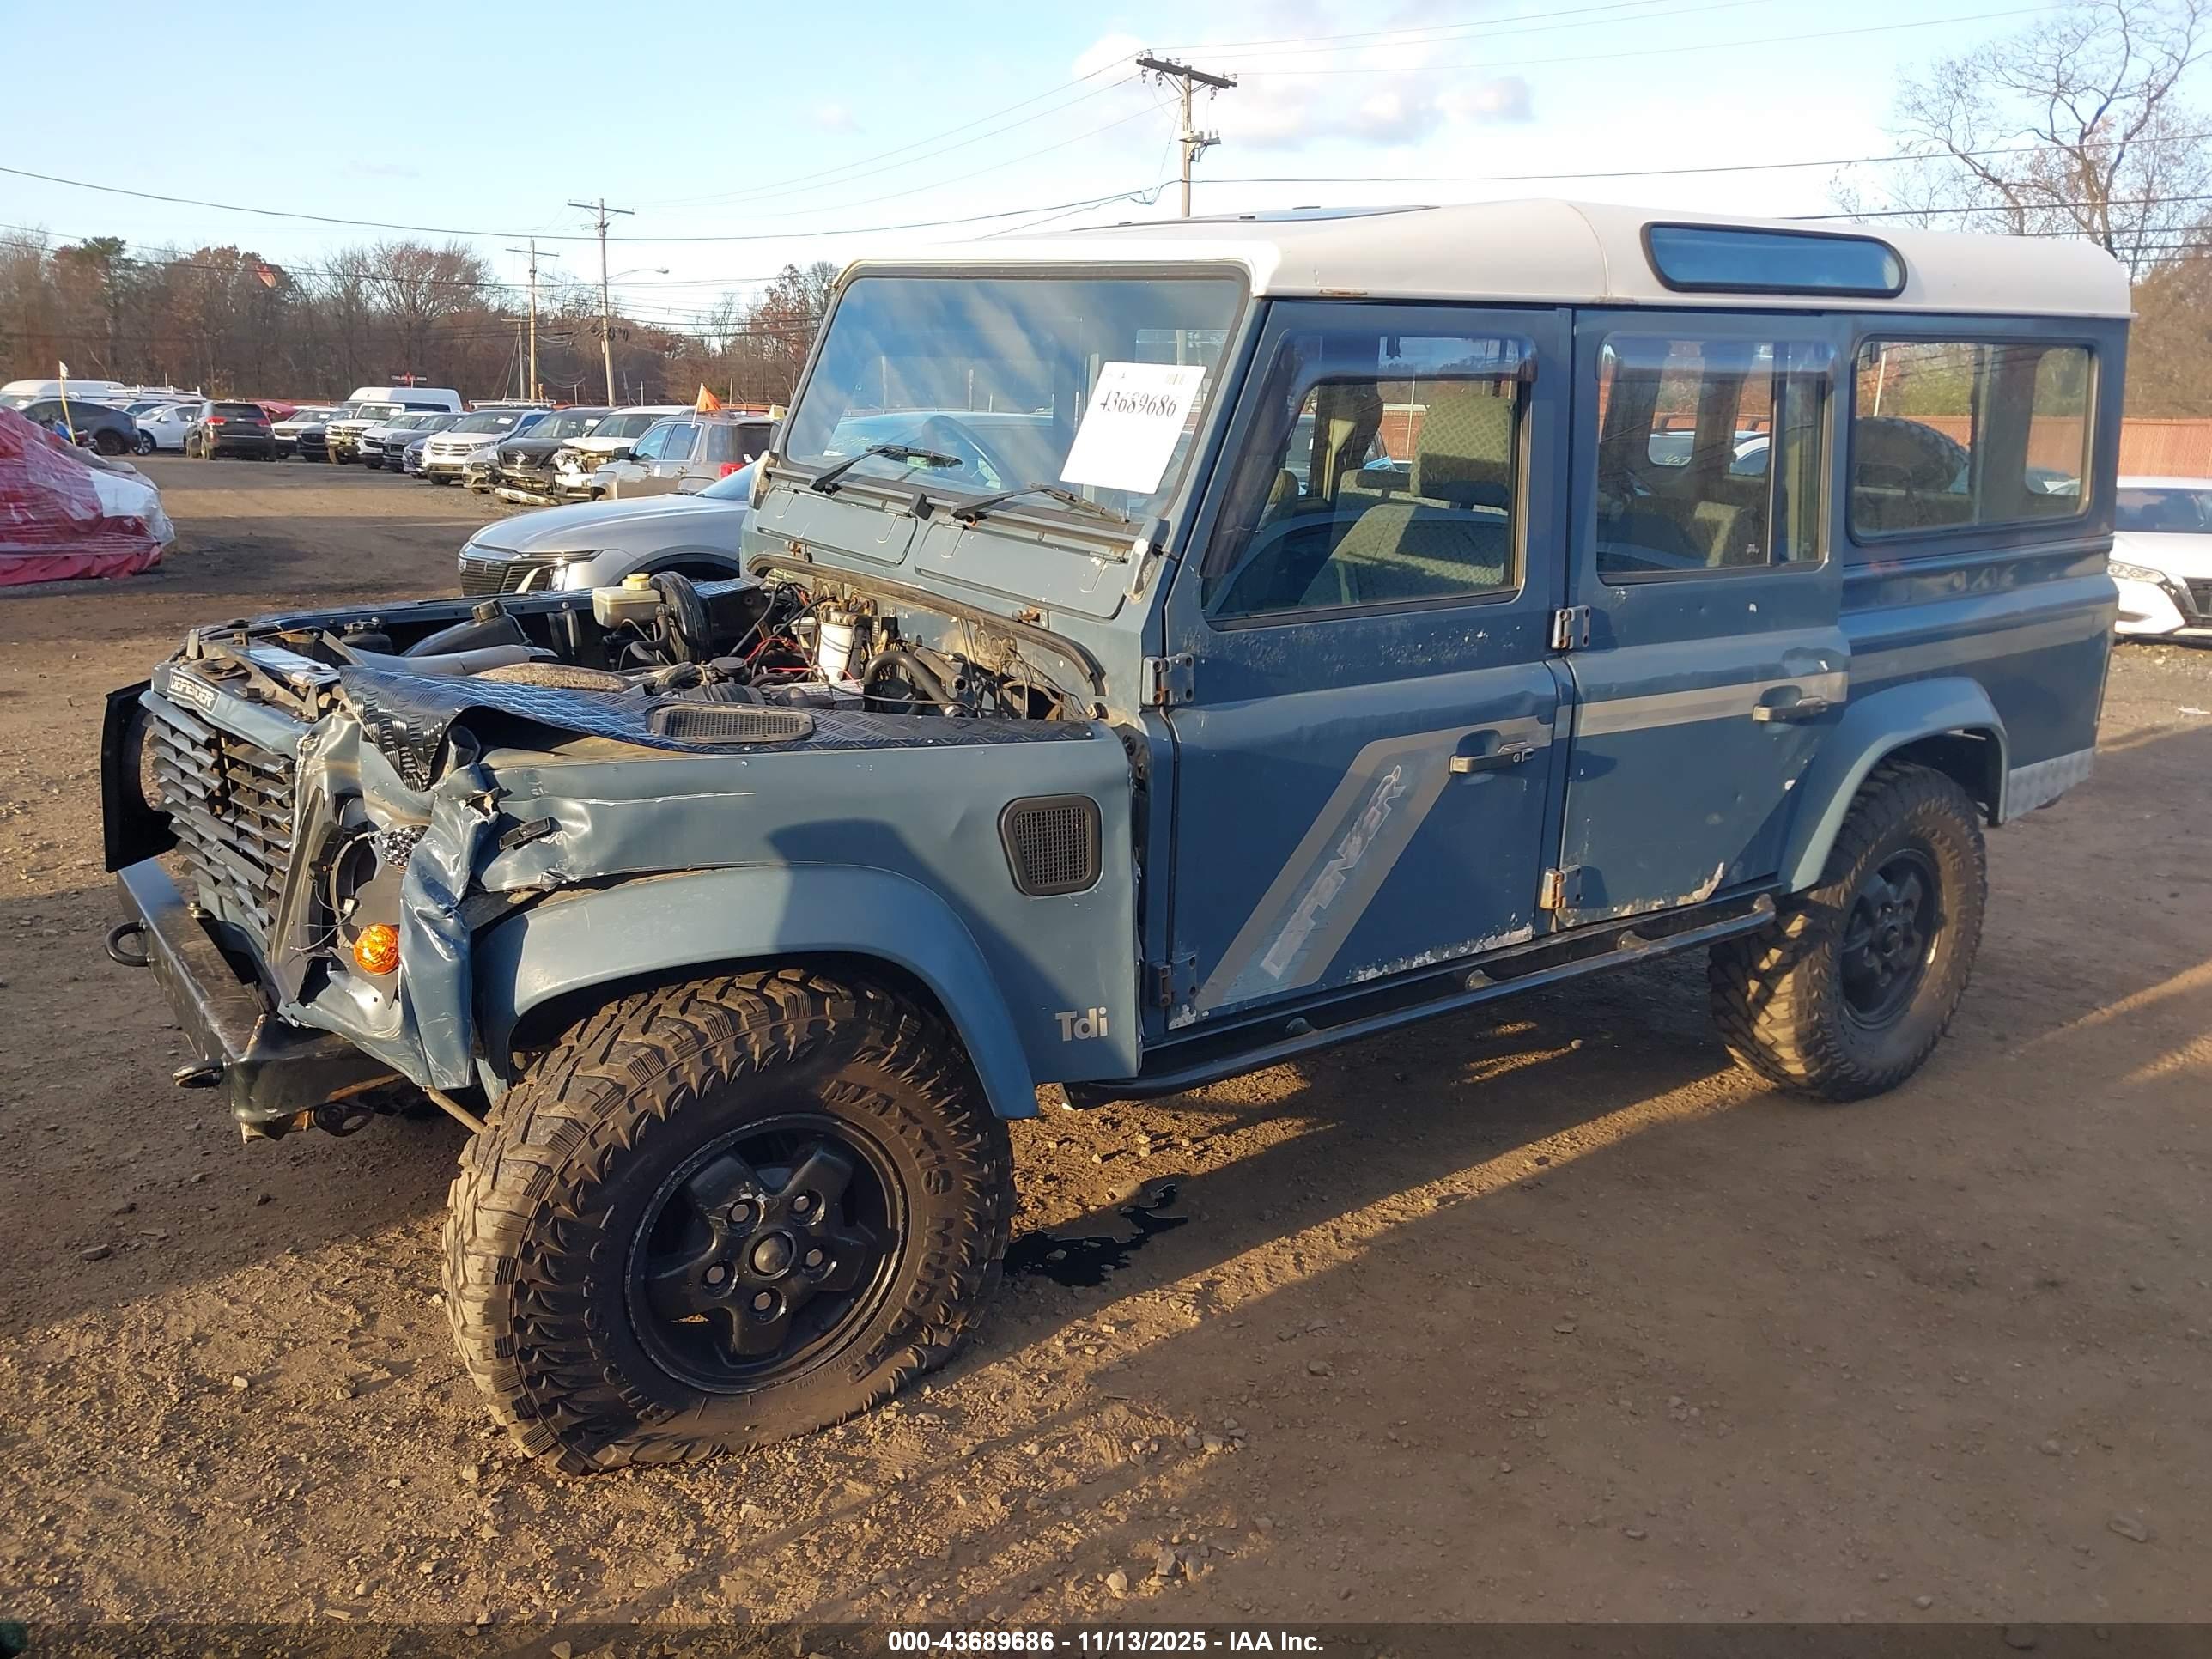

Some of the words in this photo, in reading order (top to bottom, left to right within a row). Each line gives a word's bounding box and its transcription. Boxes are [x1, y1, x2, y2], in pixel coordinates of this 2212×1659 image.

[1099, 391, 1177, 418] 43689686
[1054, 1006, 1109, 1042] Tdi
[820, 1079, 955, 1196] MAXXIS
[844, 1215, 956, 1386] MUDDER
